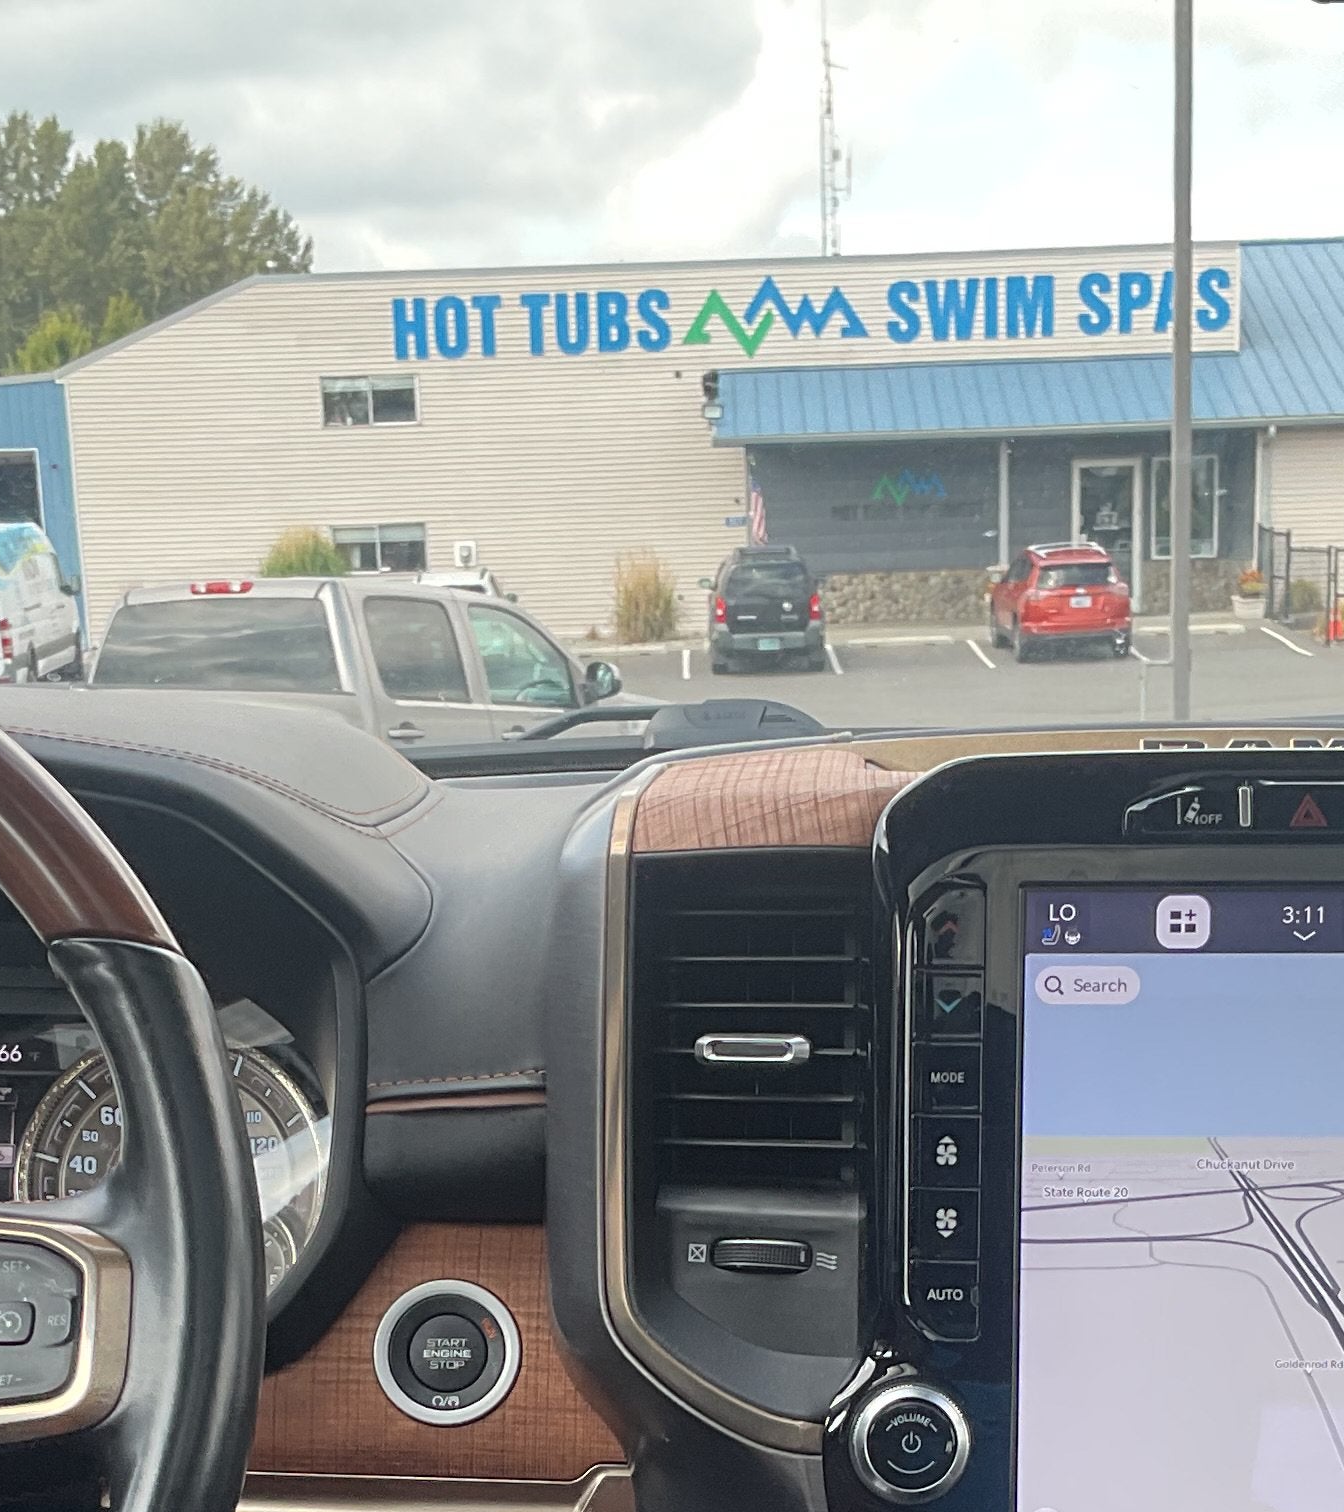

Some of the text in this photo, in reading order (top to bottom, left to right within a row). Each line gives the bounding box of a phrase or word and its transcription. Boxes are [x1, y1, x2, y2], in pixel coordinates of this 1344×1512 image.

[887, 274, 1055, 345] SWIM
[392, 288, 672, 361] HOT TUBS
[1199, 813, 1223, 825] OFF
[1048, 903, 1076, 922] LO
[1282, 905, 1326, 925] 3:11
[1073, 977, 1128, 994] Search
[930, 1072, 965, 1084] MODE
[81, 1130, 98, 1142] 50
[69, 1156, 97, 1175] 40
[1078, 1163, 1091, 1173] Rd
[1196, 1159, 1295, 1170] Chuckanut Drive
[1044, 1187, 1128, 1198] State Route 20
[926, 1288, 964, 1302] AUTO
[47, 1315, 66, 1327] RES
[426, 1338, 468, 1348] START
[423, 1349, 472, 1358] ENGINE
[429, 1360, 465, 1370] STOP
[1274, 1359, 1344, 1369] Goldenrod Rd
[890, 1414, 932, 1427] VOLUME
